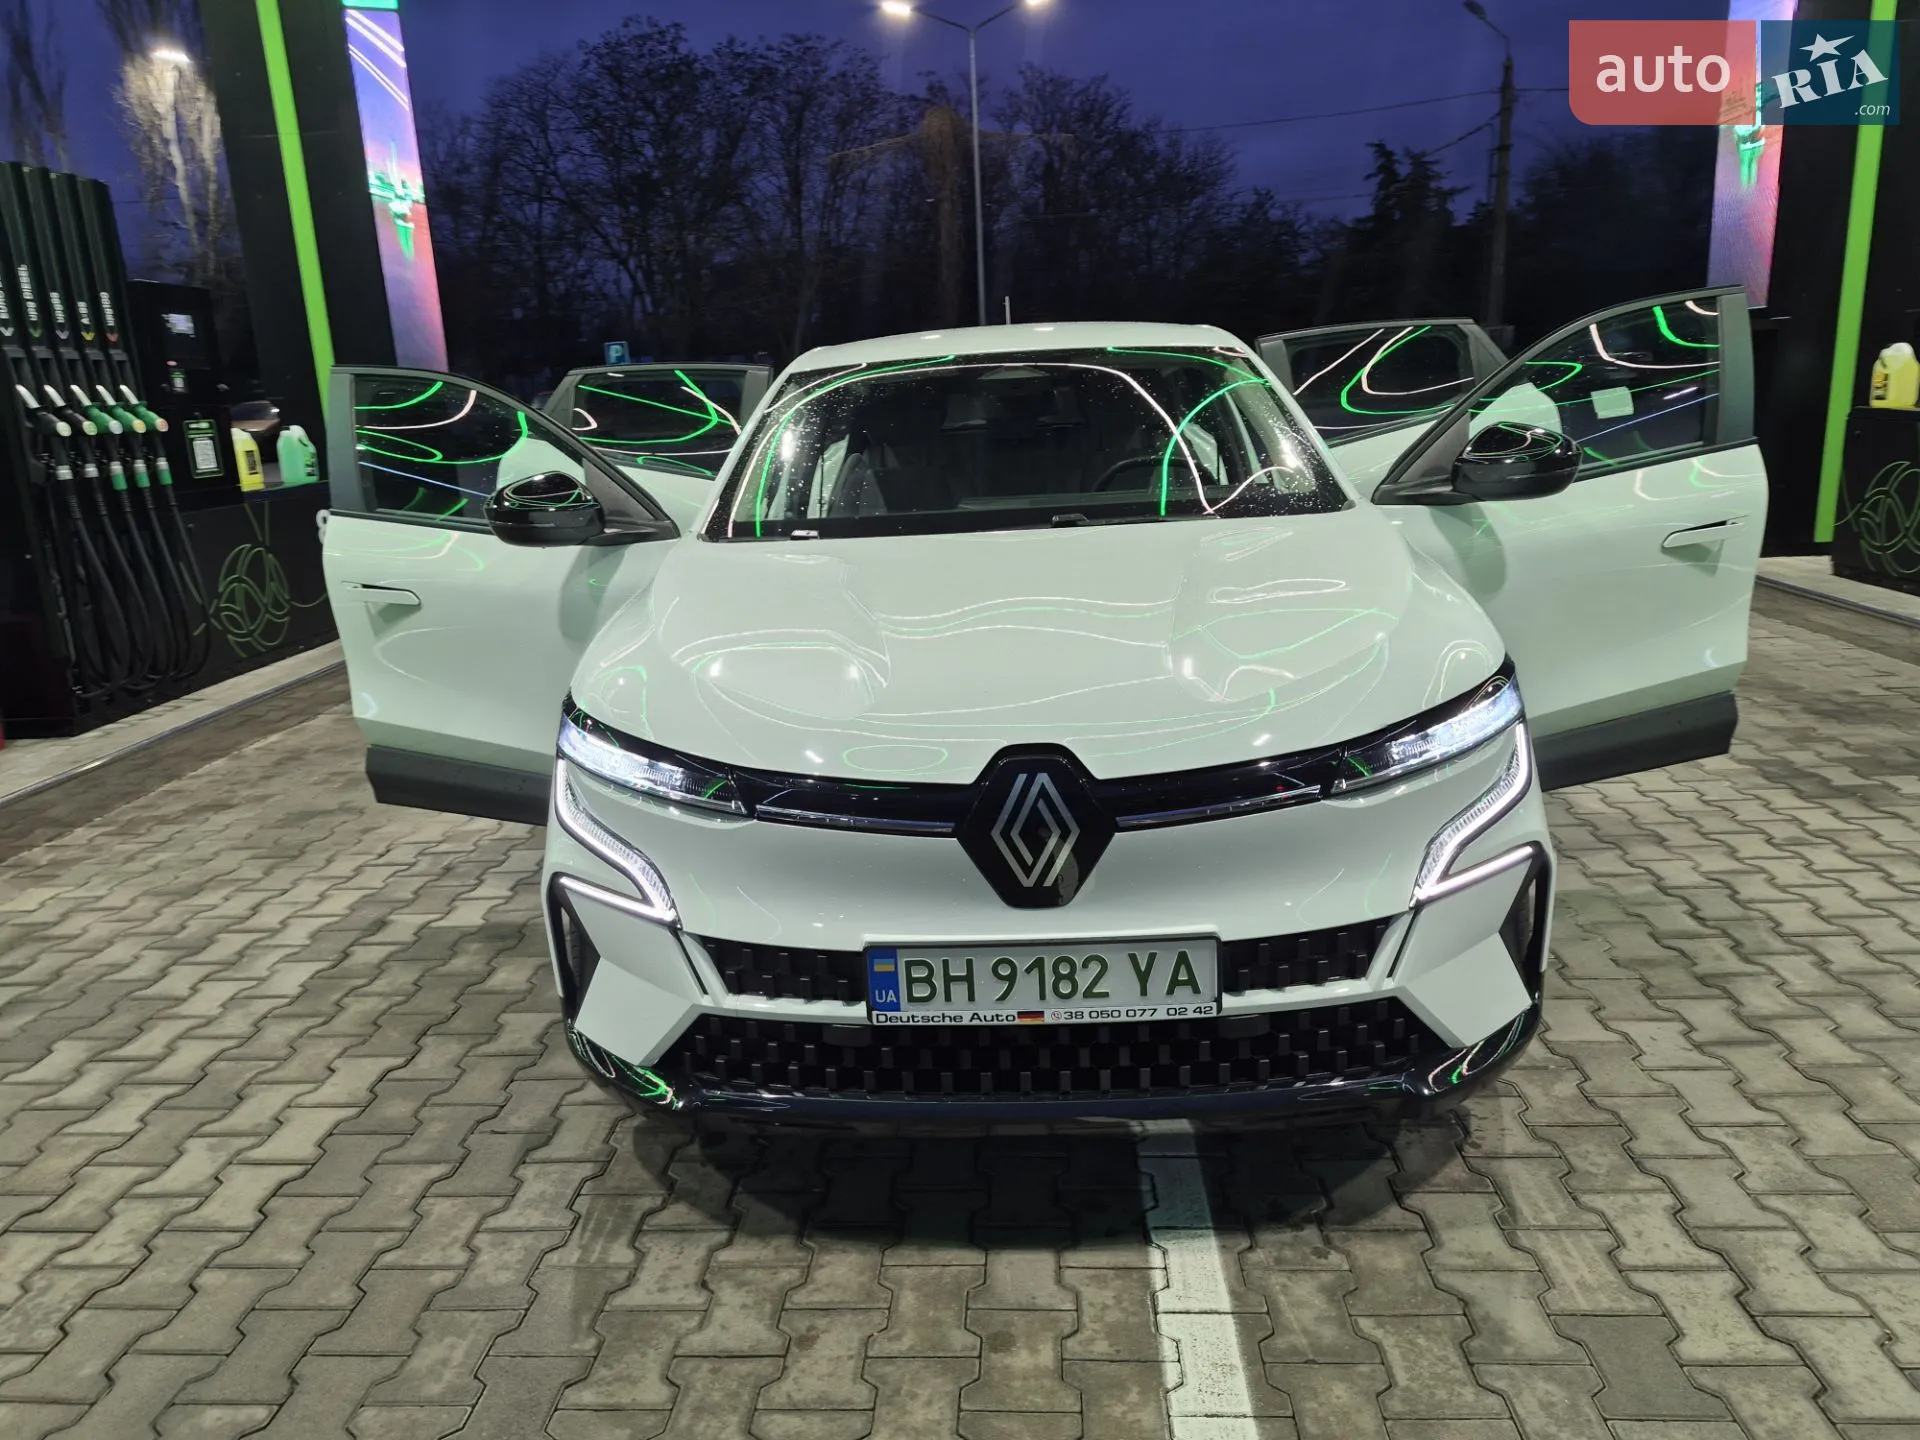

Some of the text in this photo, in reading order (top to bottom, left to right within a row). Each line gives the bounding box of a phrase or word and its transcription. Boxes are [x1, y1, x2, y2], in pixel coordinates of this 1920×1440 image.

[609, 344, 625, 363] P
[904, 950, 1202, 1003] BH 9182 YA
[875, 989, 897, 1003] UA
[875, 1005, 1214, 1024] Deutsche Auto 38 050 077 02 42
